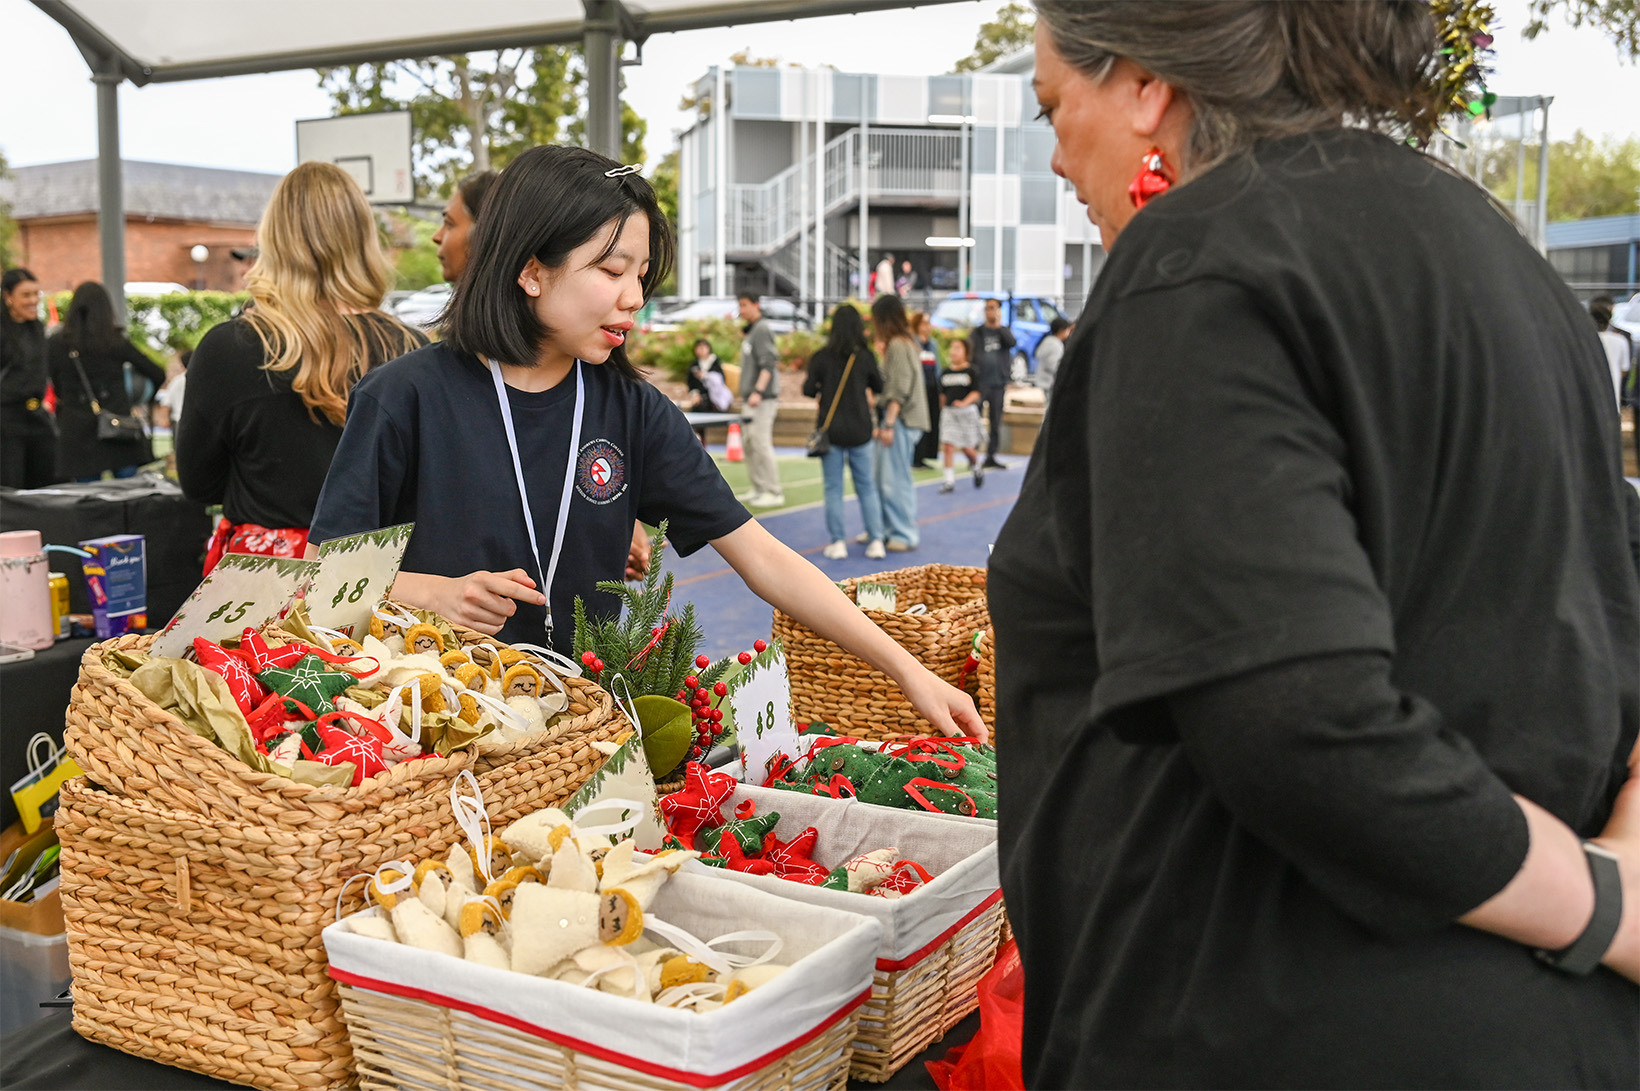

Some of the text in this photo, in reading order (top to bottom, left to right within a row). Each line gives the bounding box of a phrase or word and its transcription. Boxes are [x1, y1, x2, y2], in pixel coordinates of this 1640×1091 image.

[331, 577, 370, 608] $8
[205, 600, 255, 624] $5
[756, 700, 775, 740] $8
